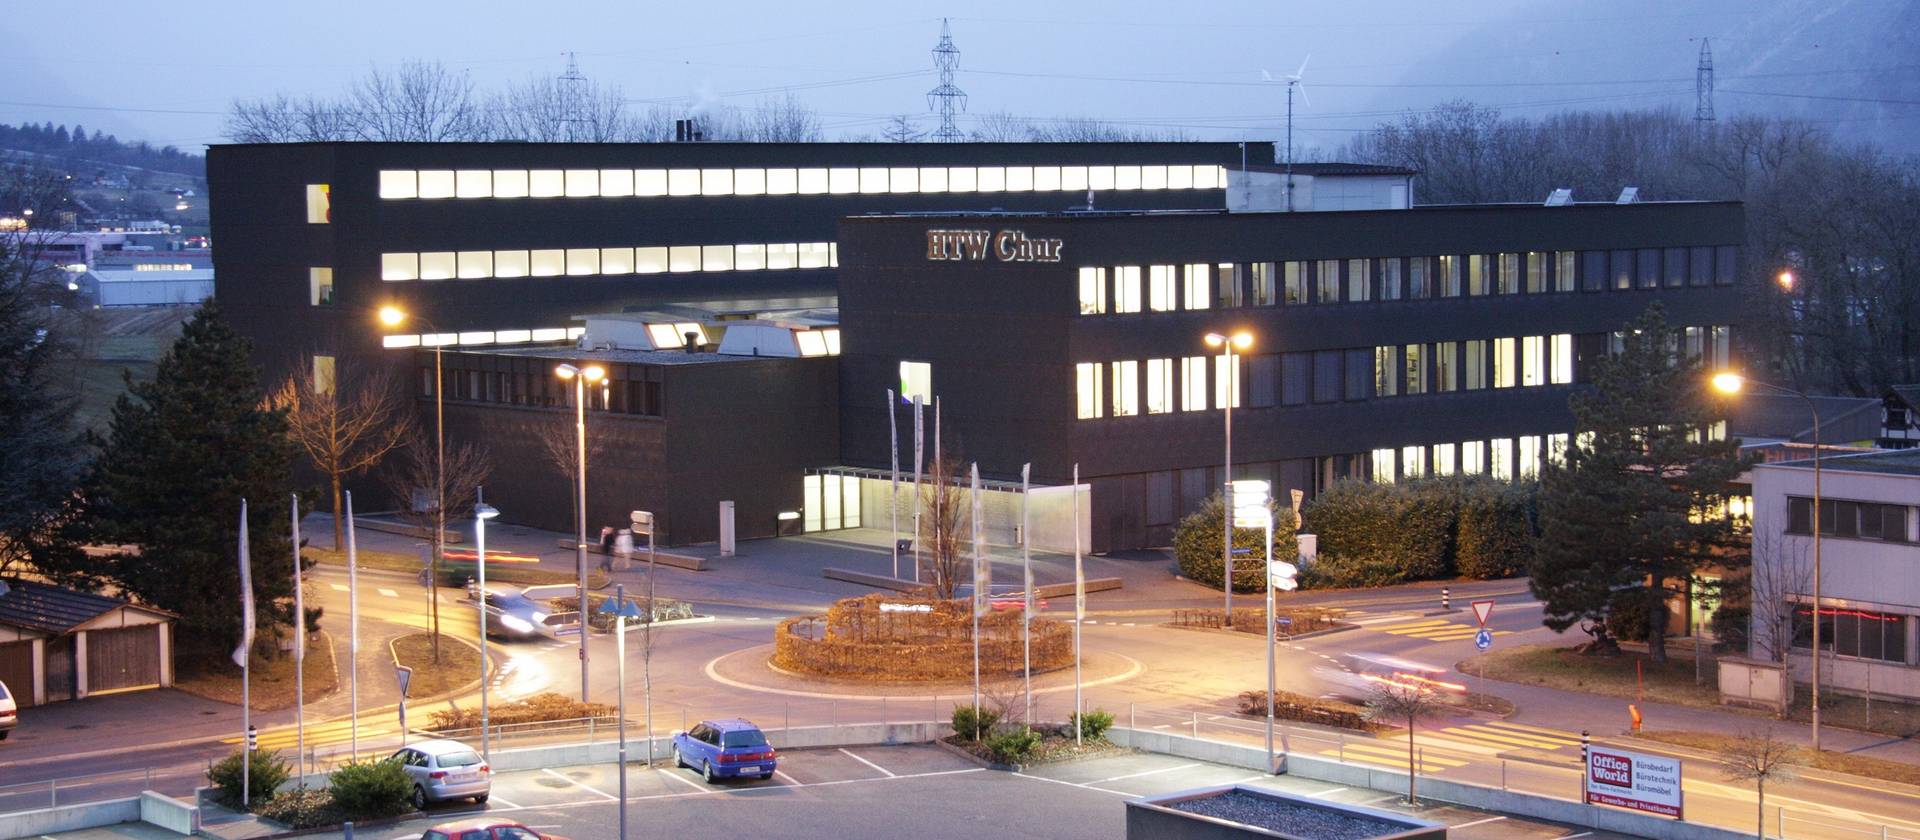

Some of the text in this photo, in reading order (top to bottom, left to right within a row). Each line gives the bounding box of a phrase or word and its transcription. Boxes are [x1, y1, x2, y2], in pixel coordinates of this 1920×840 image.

[927, 229, 1063, 262] HTW Chur
[1593, 755, 1628, 771] Office
[1636, 760, 1673, 773] Bürobedarf
[1593, 766, 1629, 783] World
[1636, 771, 1677, 785] Bürotechnik
[1636, 783, 1672, 796] Büromöbel
